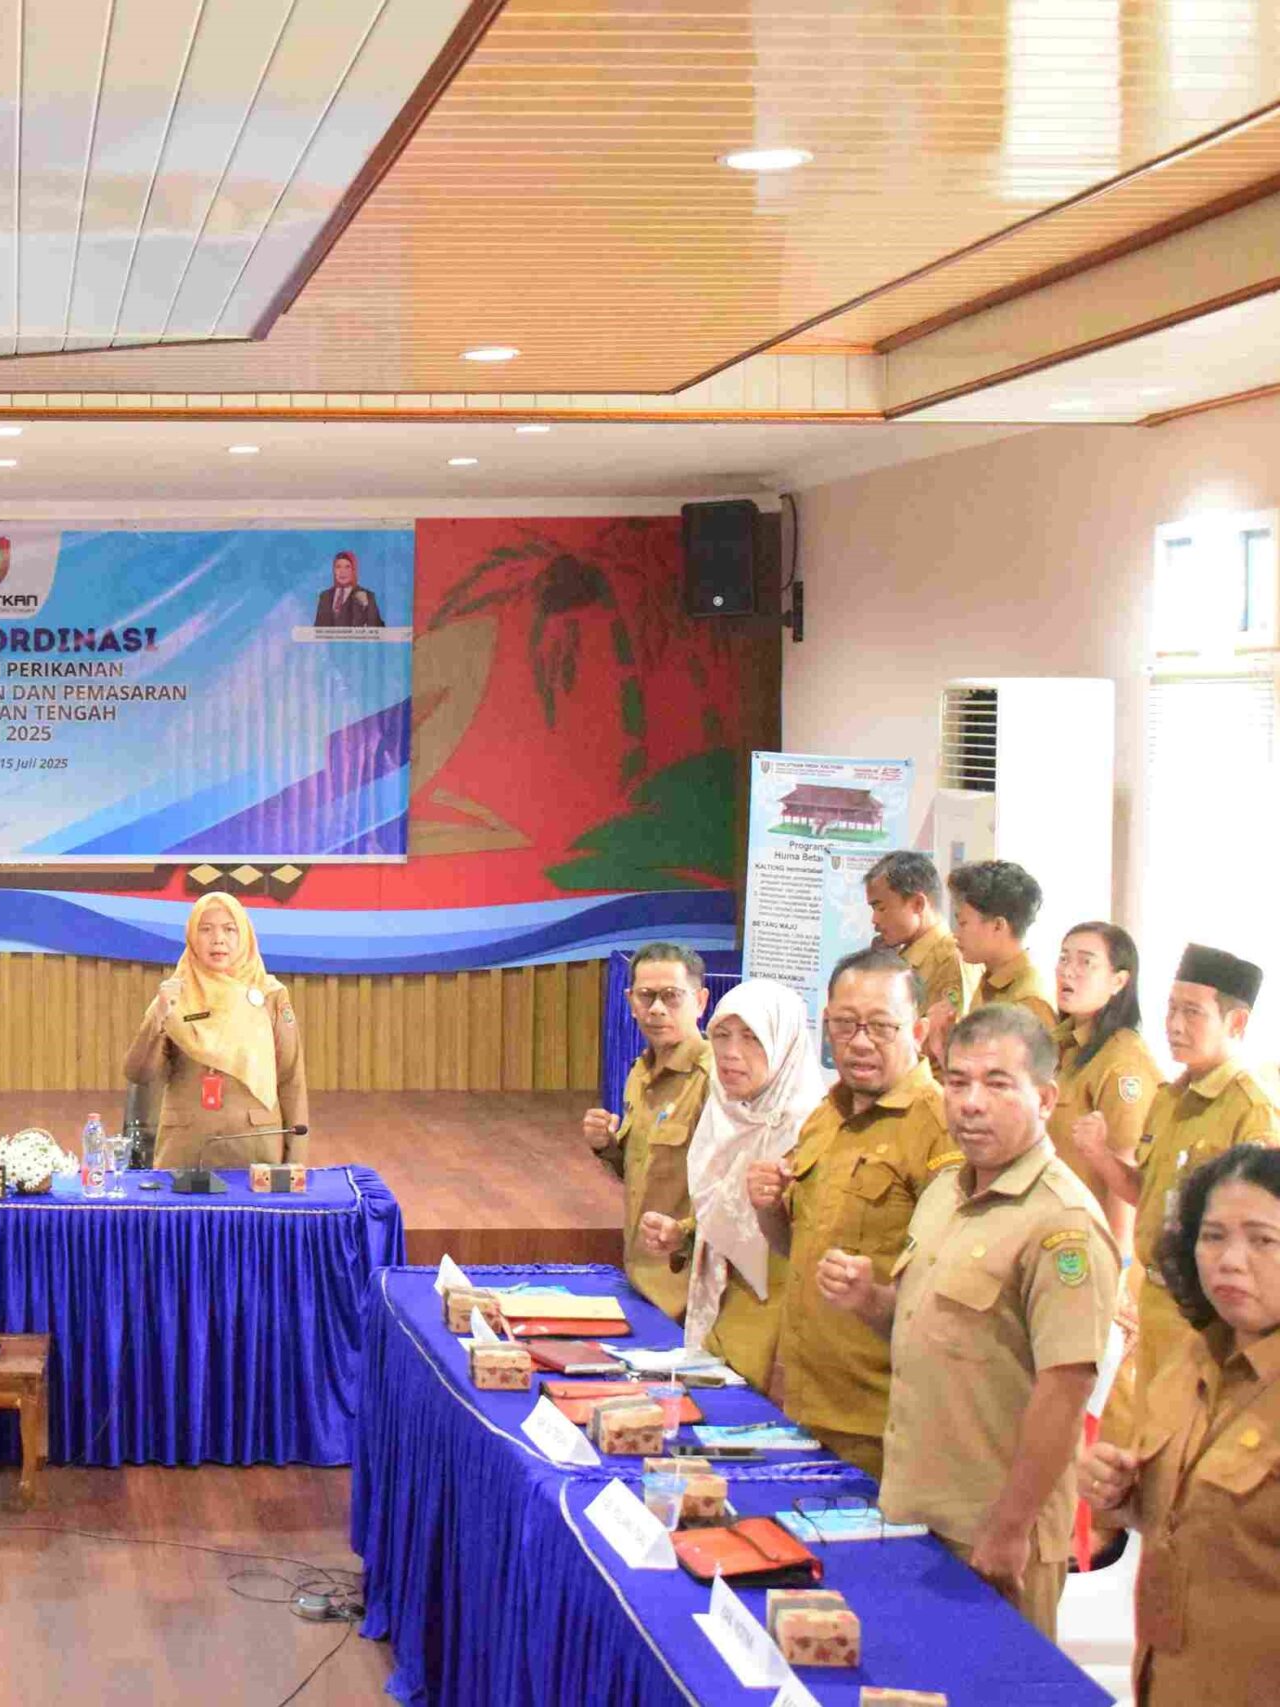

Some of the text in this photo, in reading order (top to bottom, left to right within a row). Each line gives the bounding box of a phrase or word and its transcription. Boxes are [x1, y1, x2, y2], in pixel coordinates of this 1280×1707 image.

[7, 661, 124, 678] PERIKANAN
[12, 684, 56, 701] DAN
[63, 684, 187, 701] PEMASARAN
[34, 704, 117, 721] TENGAH
[6, 725, 52, 741] 2025
[0, 758, 14, 769] 15
[16, 758, 36, 772] Juli
[38, 758, 69, 769] 2025
